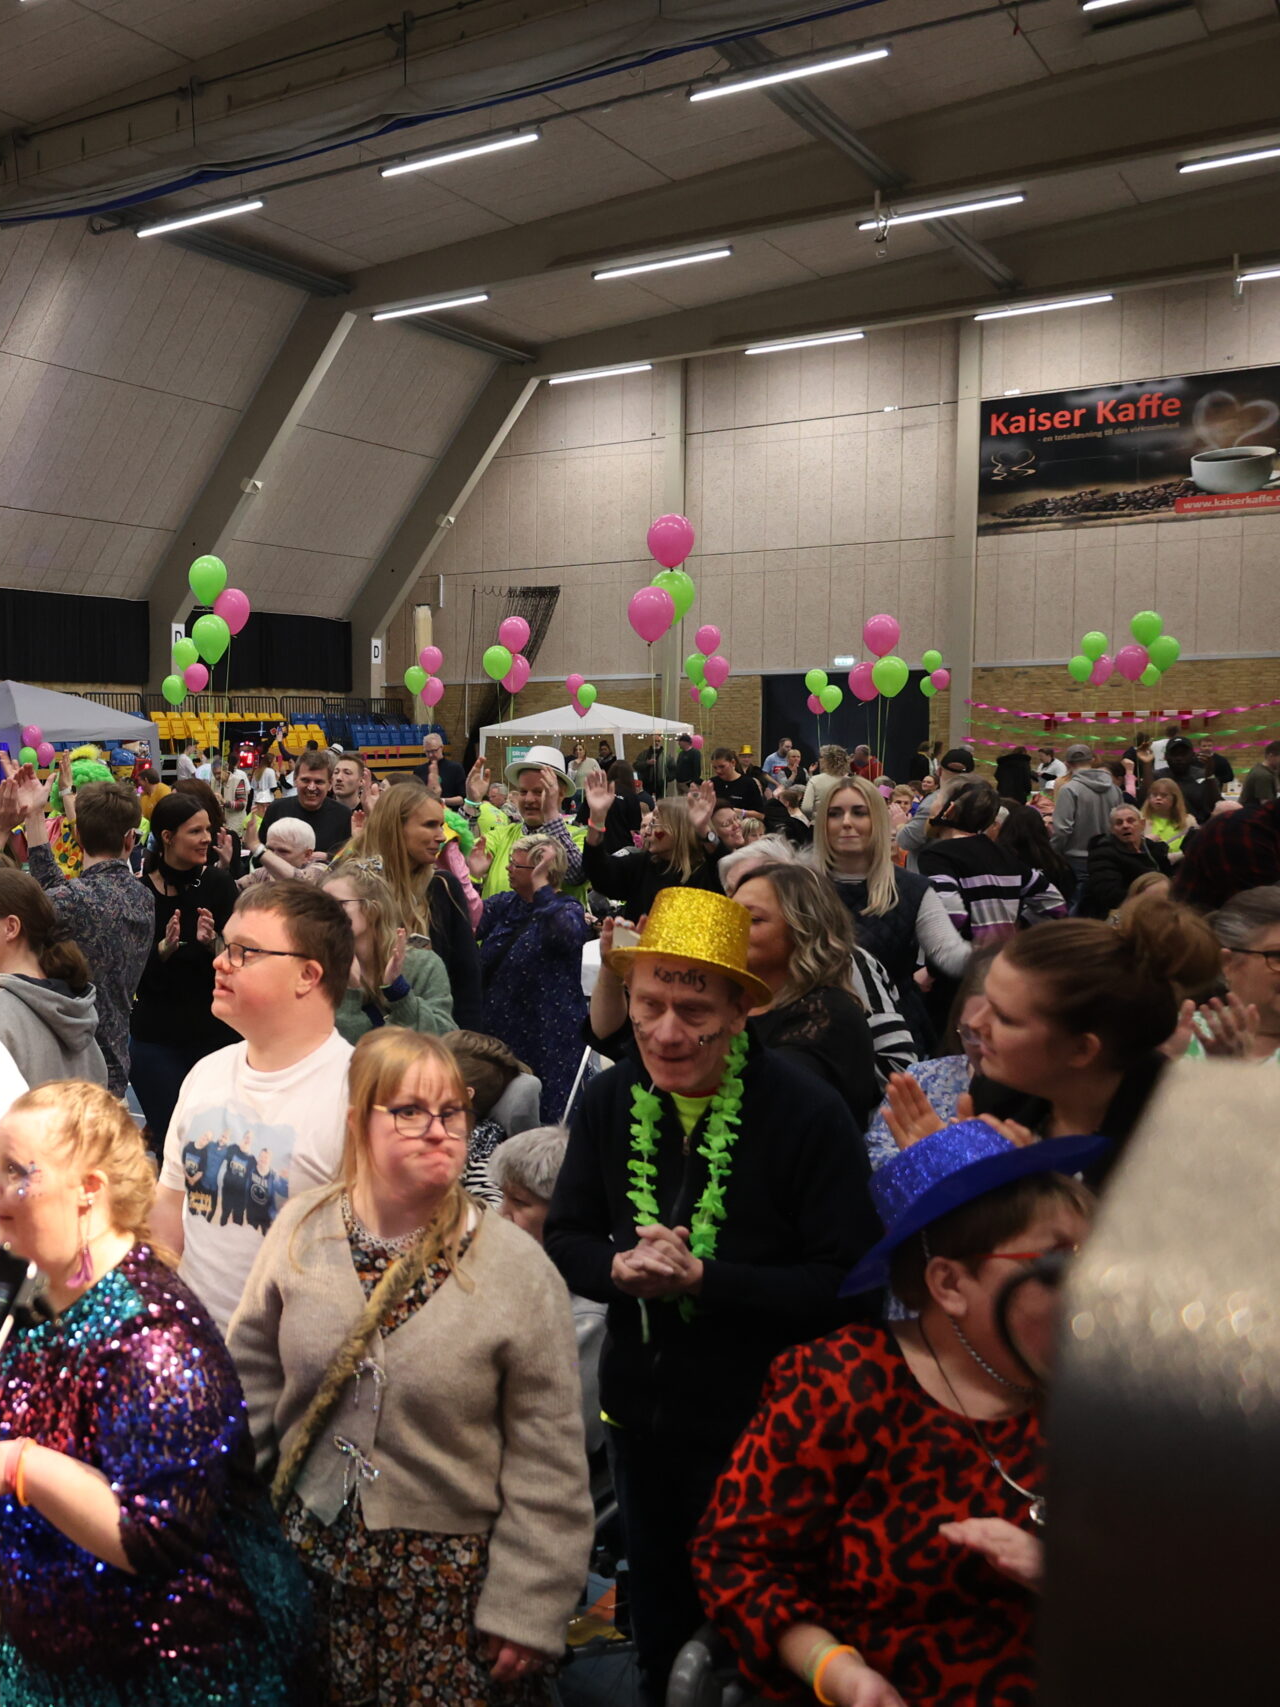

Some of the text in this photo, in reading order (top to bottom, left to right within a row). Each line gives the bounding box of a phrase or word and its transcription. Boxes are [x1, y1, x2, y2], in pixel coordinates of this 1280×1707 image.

[990, 392, 1182, 436] Kaiser Kaffe
[373, 645, 380, 658] D
